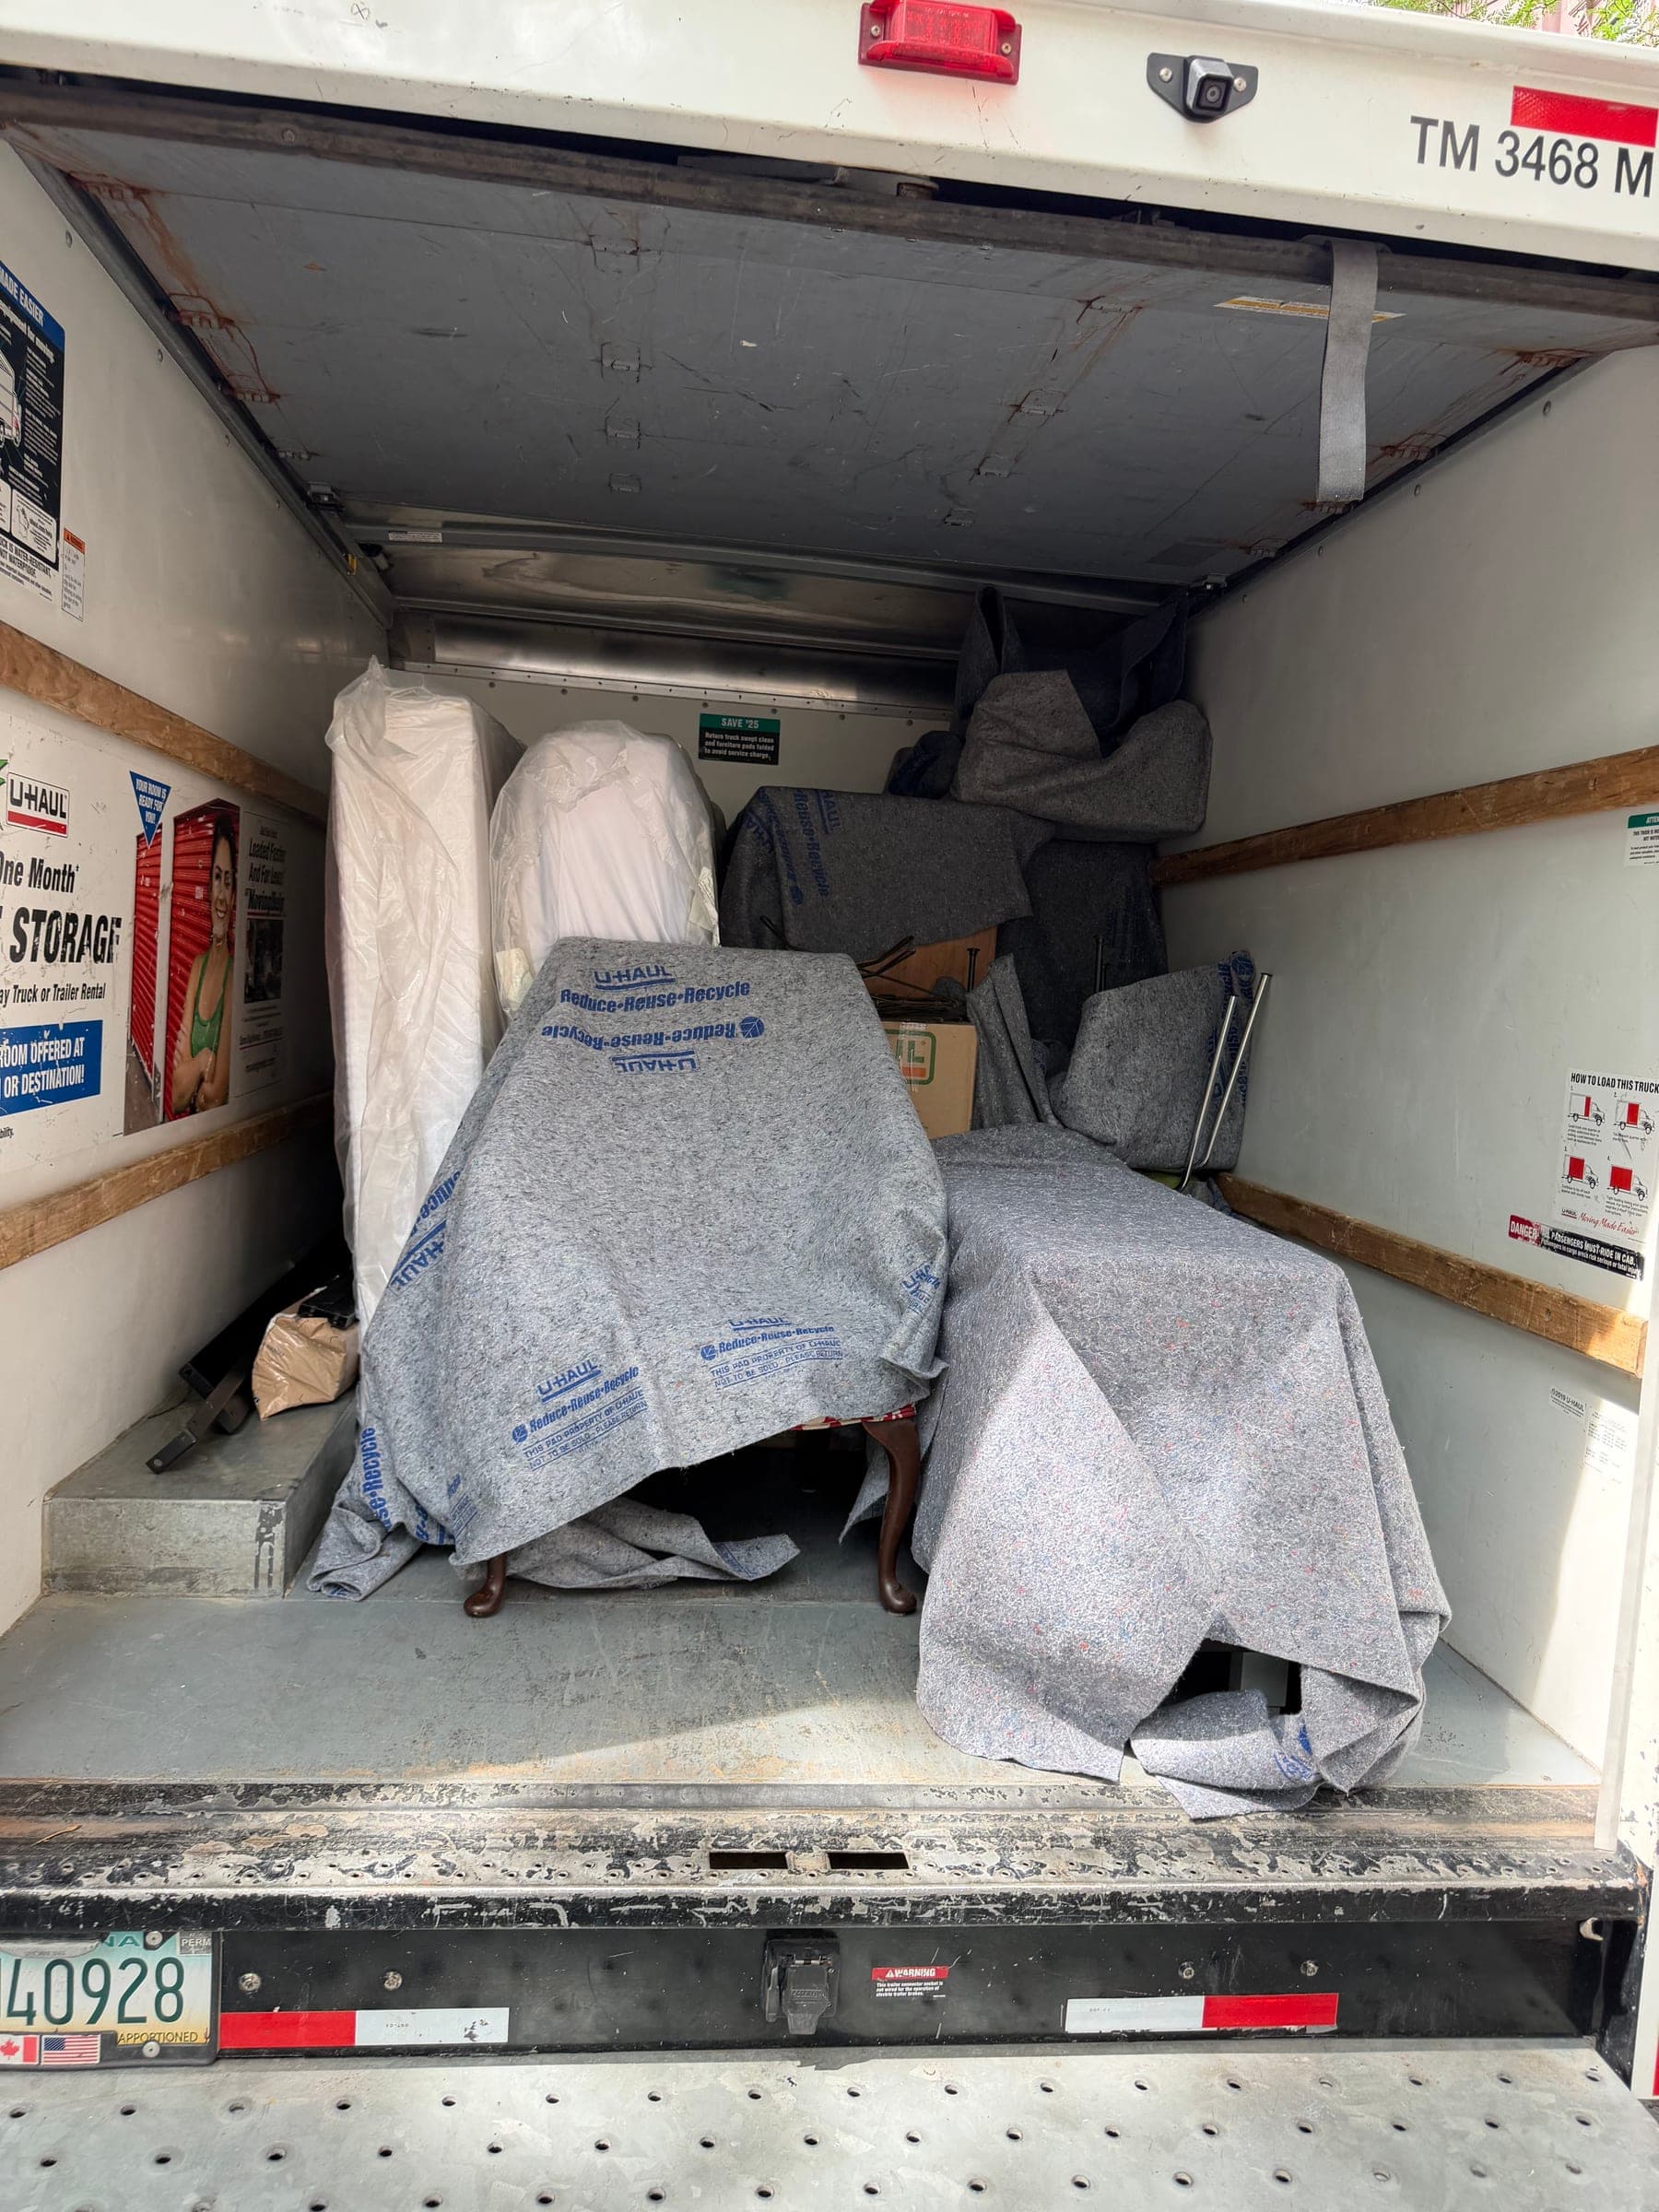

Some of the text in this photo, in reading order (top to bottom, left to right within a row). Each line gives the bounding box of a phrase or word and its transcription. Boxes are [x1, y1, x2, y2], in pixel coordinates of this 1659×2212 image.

[1410, 115, 1654, 197] TM 3468 M
[722, 717, 743, 728] SAVE
[9, 779, 67, 819] U-HAUL
[594, 964, 673, 984] U-HAUL
[13, 983, 39, 1005] Truck
[41, 986, 51, 1002] or
[53, 982, 79, 1002] Trailer
[80, 982, 107, 999] Rental
[29, 1037, 72, 1065] OFFERED
[74, 1036, 86, 1057] AT
[614, 1057, 698, 1075] U-HAUL
[4, 1064, 85, 1099] OR DESTINATION!
[1570, 1072, 1659, 1095] HOW TO LOAD THIS TRUCK
[1583, 1240, 1601, 1254] MUST
[710, 1365, 731, 1379] THIS
[731, 1359, 750, 1371] PAD
[750, 1347, 796, 1365] PROPERTY
[535, 1359, 600, 1396] U-HAUL
[523, 1444, 545, 1459] THIS
[544, 1434, 564, 1450] PAD
[563, 1413, 605, 1440] PROPERTY
[603, 1405, 616, 1418] OF
[181, 1937, 212, 1947] PERM
[894, 1968, 936, 1978] WARNING
[0, 1956, 185, 2027] 40928
[117, 2030, 199, 2044] APPORTIONED
